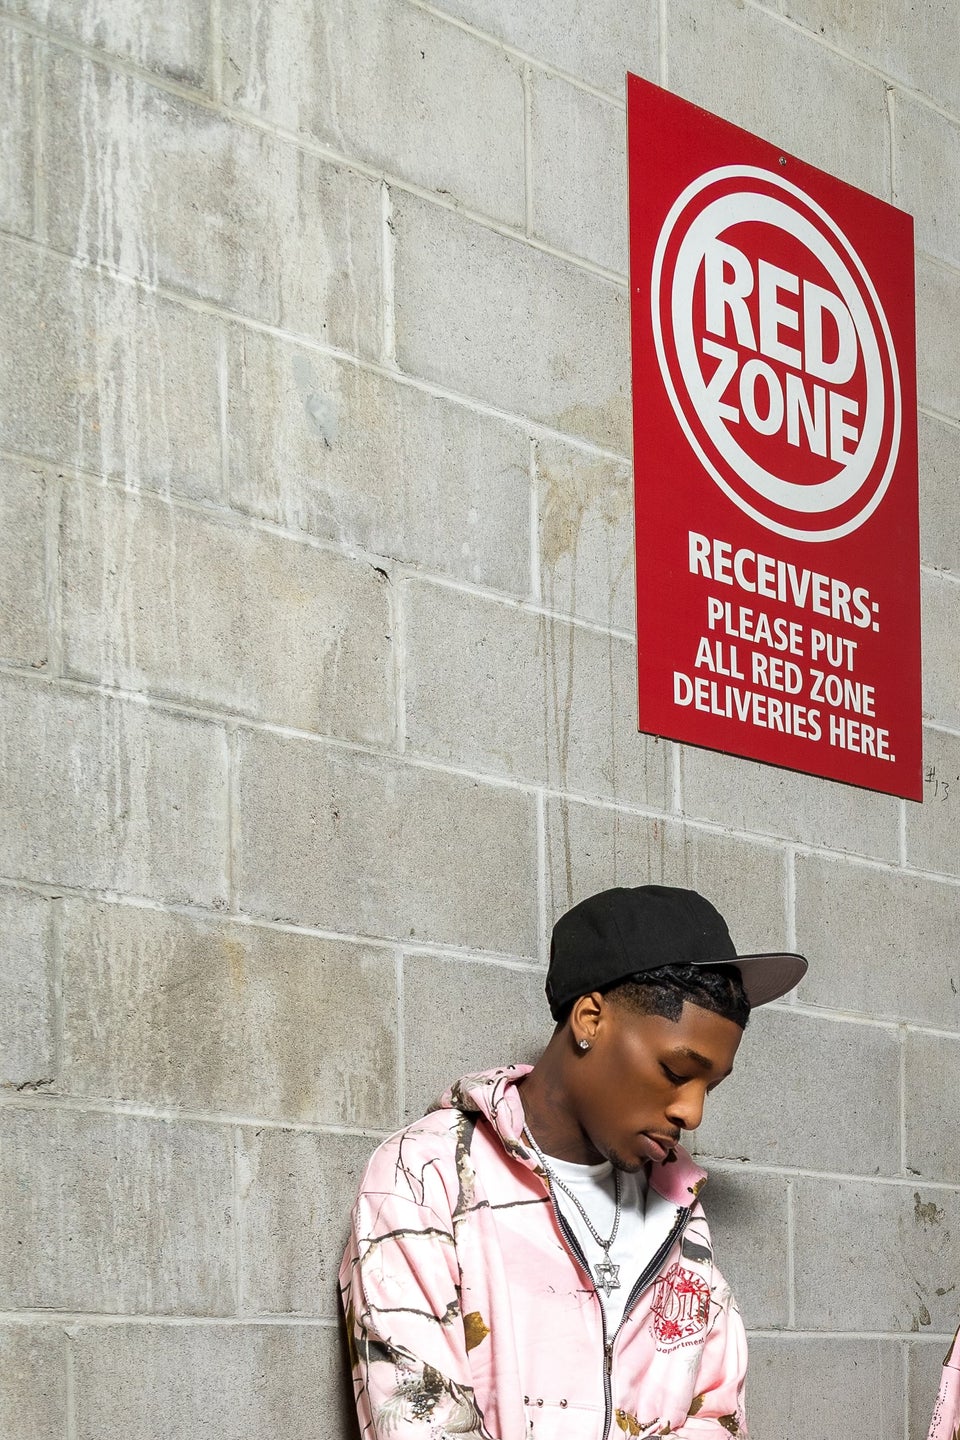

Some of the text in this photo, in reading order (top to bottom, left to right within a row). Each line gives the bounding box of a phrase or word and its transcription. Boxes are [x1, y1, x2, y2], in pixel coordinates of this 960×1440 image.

[704, 231, 858, 385] RED
[702, 337, 859, 467] ZONE
[688, 530, 880, 633] RECEIVERS:
[694, 636, 876, 718] ALL RED ZONE
[707, 596, 858, 672] PLEASE PUT
[673, 670, 896, 763] DELIVERIES HERE.
